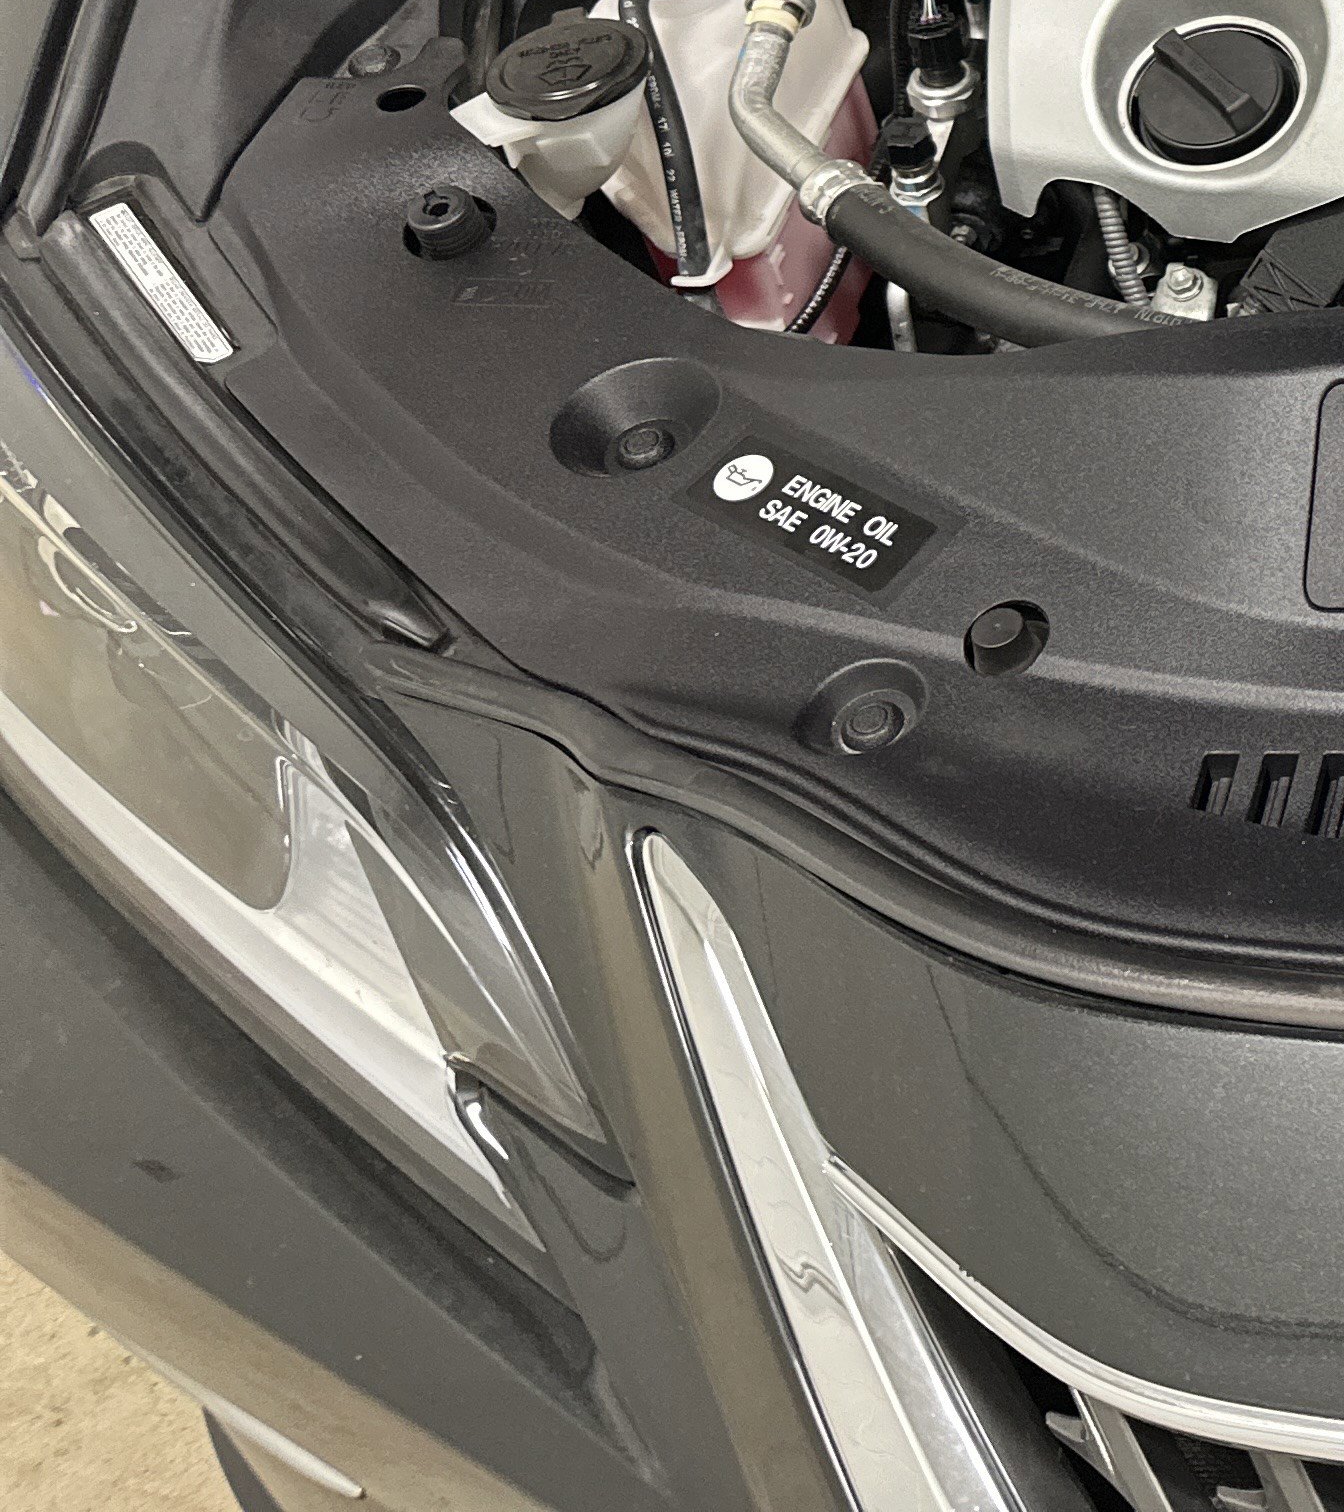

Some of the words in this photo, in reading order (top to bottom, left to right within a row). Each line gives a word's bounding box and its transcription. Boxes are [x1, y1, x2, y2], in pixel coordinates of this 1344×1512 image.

[759, 498, 809, 533] SAE
[809, 524, 878, 570] 0W-20
[782, 474, 863, 524] ENGINE
[863, 515, 899, 547] OIL
